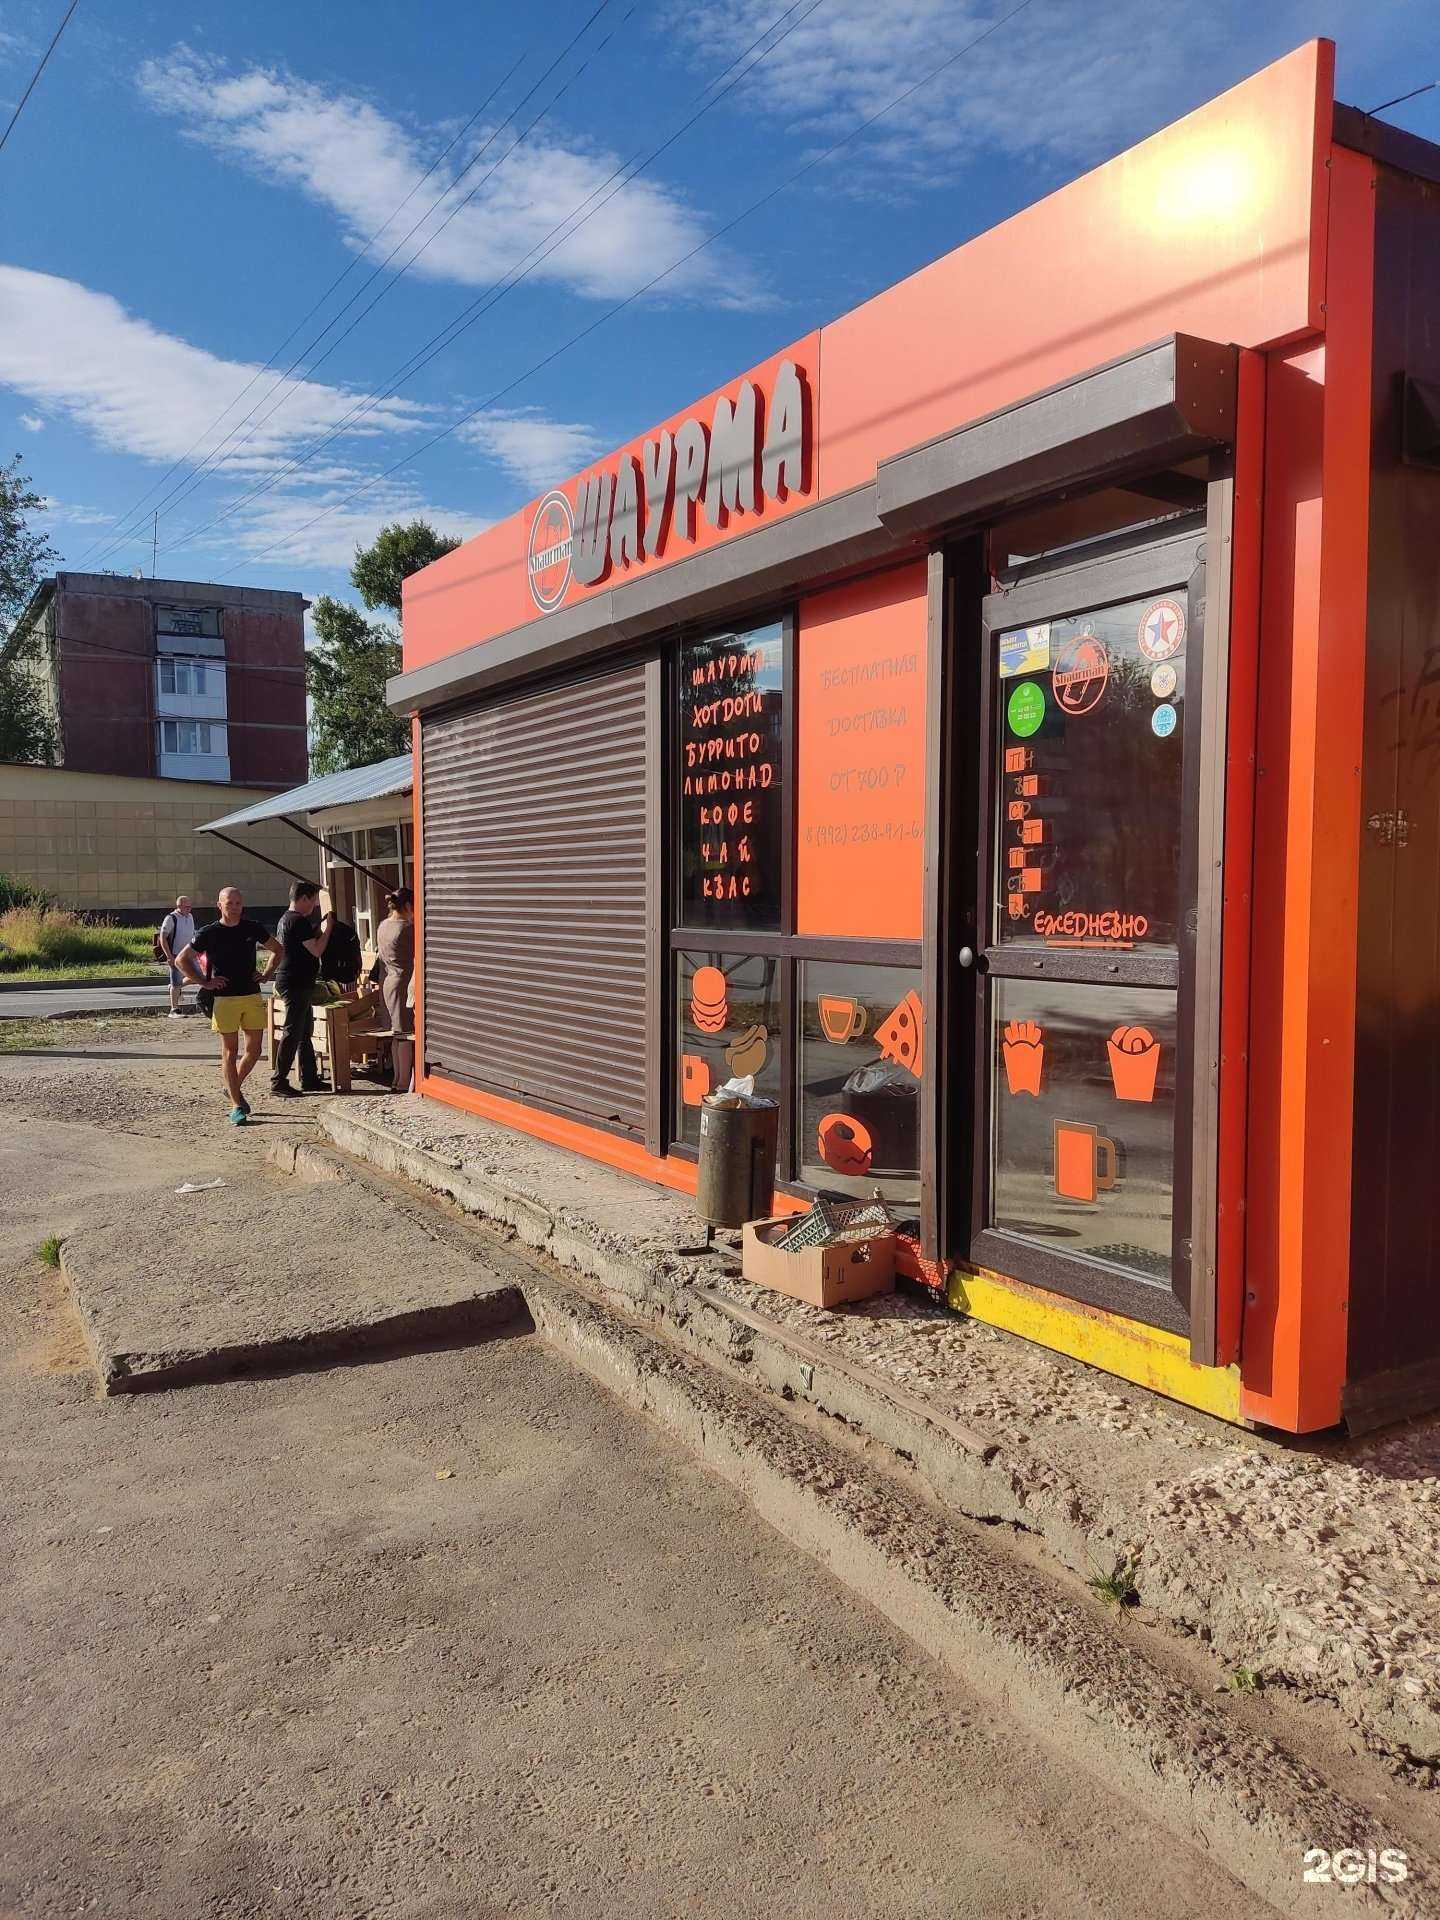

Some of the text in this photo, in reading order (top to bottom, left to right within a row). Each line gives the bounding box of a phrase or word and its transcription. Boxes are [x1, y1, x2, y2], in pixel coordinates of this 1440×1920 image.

[572, 359, 811, 586] ШАУРМА
[692, 649, 764, 686] ШАУРМА
[820, 655, 917, 688] БЕСПЛАТНАЯ
[1055, 664, 1107, 685] Shaurman
[827, 705, 906, 736] ДОСТАВКА
[685, 732, 760, 767] БУРРИТО
[684, 763, 772, 795] ЛИМОНАД
[830, 768, 857, 792] ОТ
[700, 801, 753, 826] КОФЕ
[702, 835, 751, 863] ЧАЙ
[703, 874, 750, 900] КВАС
[1034, 911, 1148, 938] ЕЖЕДНЕВНО
